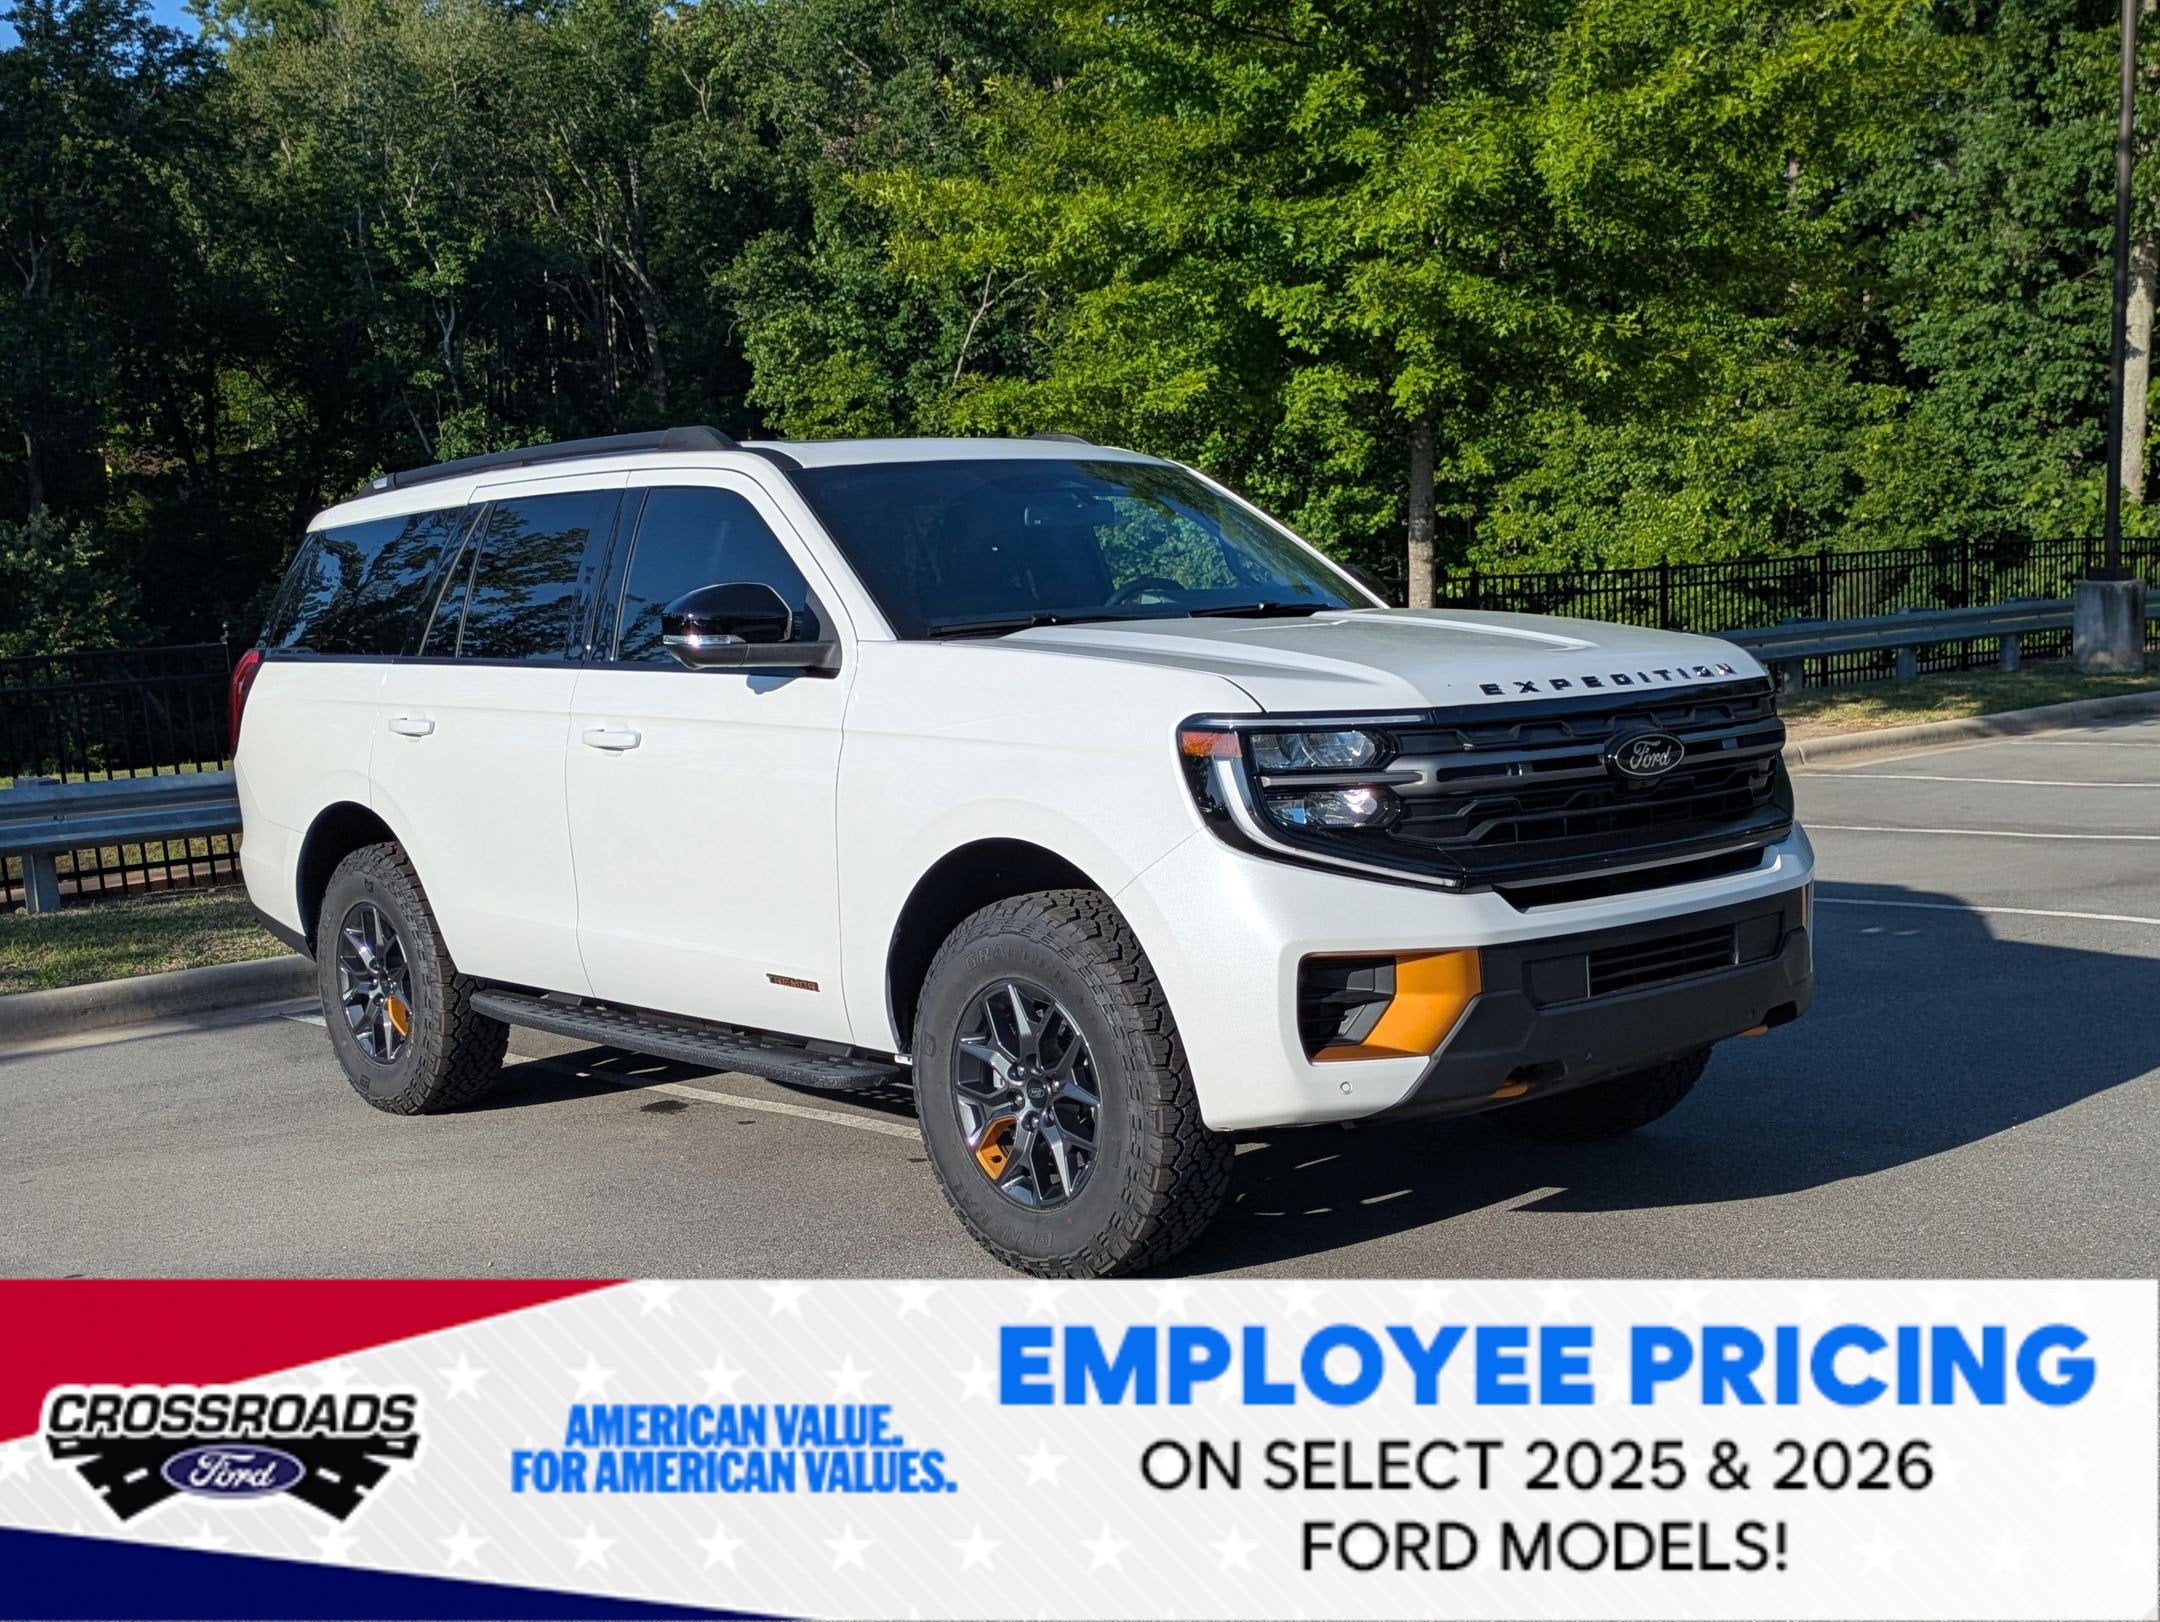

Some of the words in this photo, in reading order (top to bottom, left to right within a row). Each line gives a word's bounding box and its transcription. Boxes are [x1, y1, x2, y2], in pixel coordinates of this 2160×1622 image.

[1479, 663, 1738, 696] EXPEDITION
[1629, 739, 1672, 770] Ford
[766, 973, 820, 992] TREMOR
